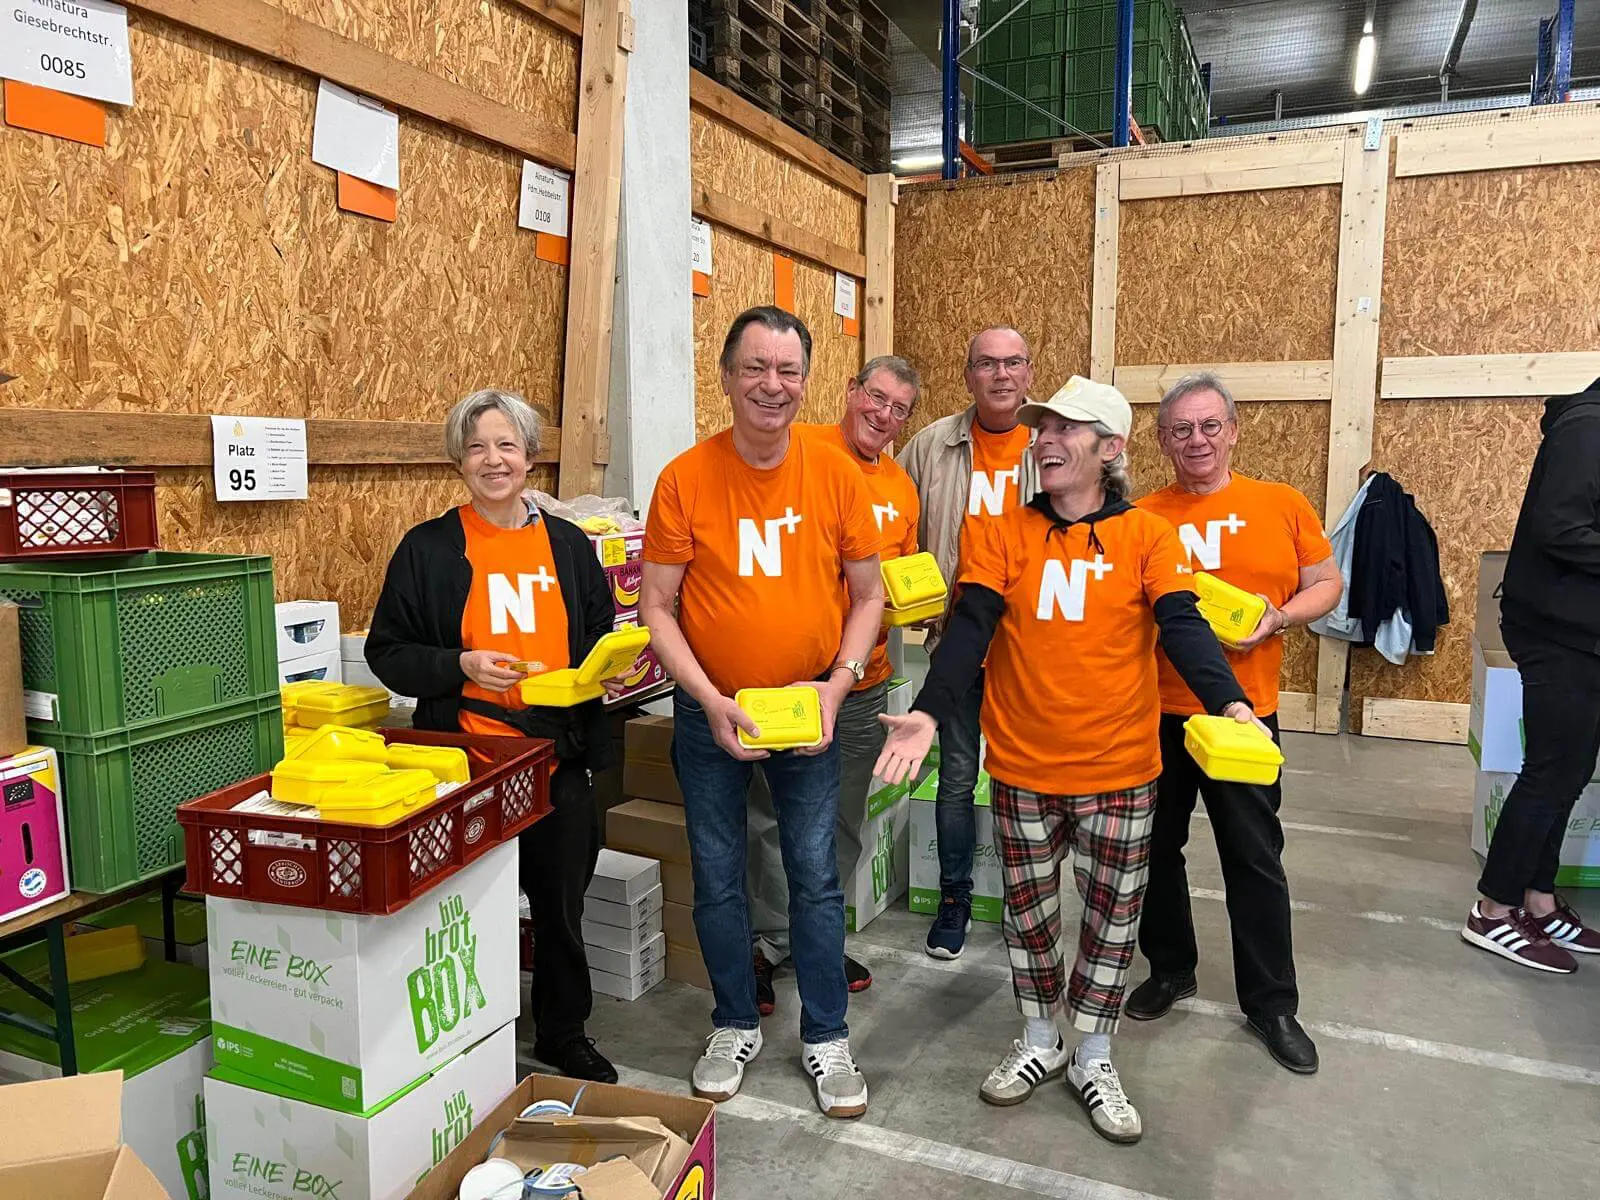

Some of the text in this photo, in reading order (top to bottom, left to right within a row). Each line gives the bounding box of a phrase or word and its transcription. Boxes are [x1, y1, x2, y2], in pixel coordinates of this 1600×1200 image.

[13, 8, 113, 47] Giesebrechtstr.
[40, 53, 86, 79] 0085
[534, 208, 551, 223] 0108
[228, 444, 255, 456] Platz
[229, 469, 256, 491] 95
[439, 893, 464, 929] bio
[425, 910, 471, 967] brot
[231, 940, 333, 986] EINE BOX
[222, 966, 246, 979] voller
[246, 971, 288, 992] Leckereien
[293, 986, 307, 998] gut
[308, 991, 344, 1009] verpackt
[407, 934, 487, 1055] BOX
[226, 1040, 241, 1055] IPS
[444, 1089, 466, 1126] bio
[432, 1103, 473, 1166] brot
[223, 1178, 247, 1191] voller
[231, 1152, 343, 1200] EINE BOX
